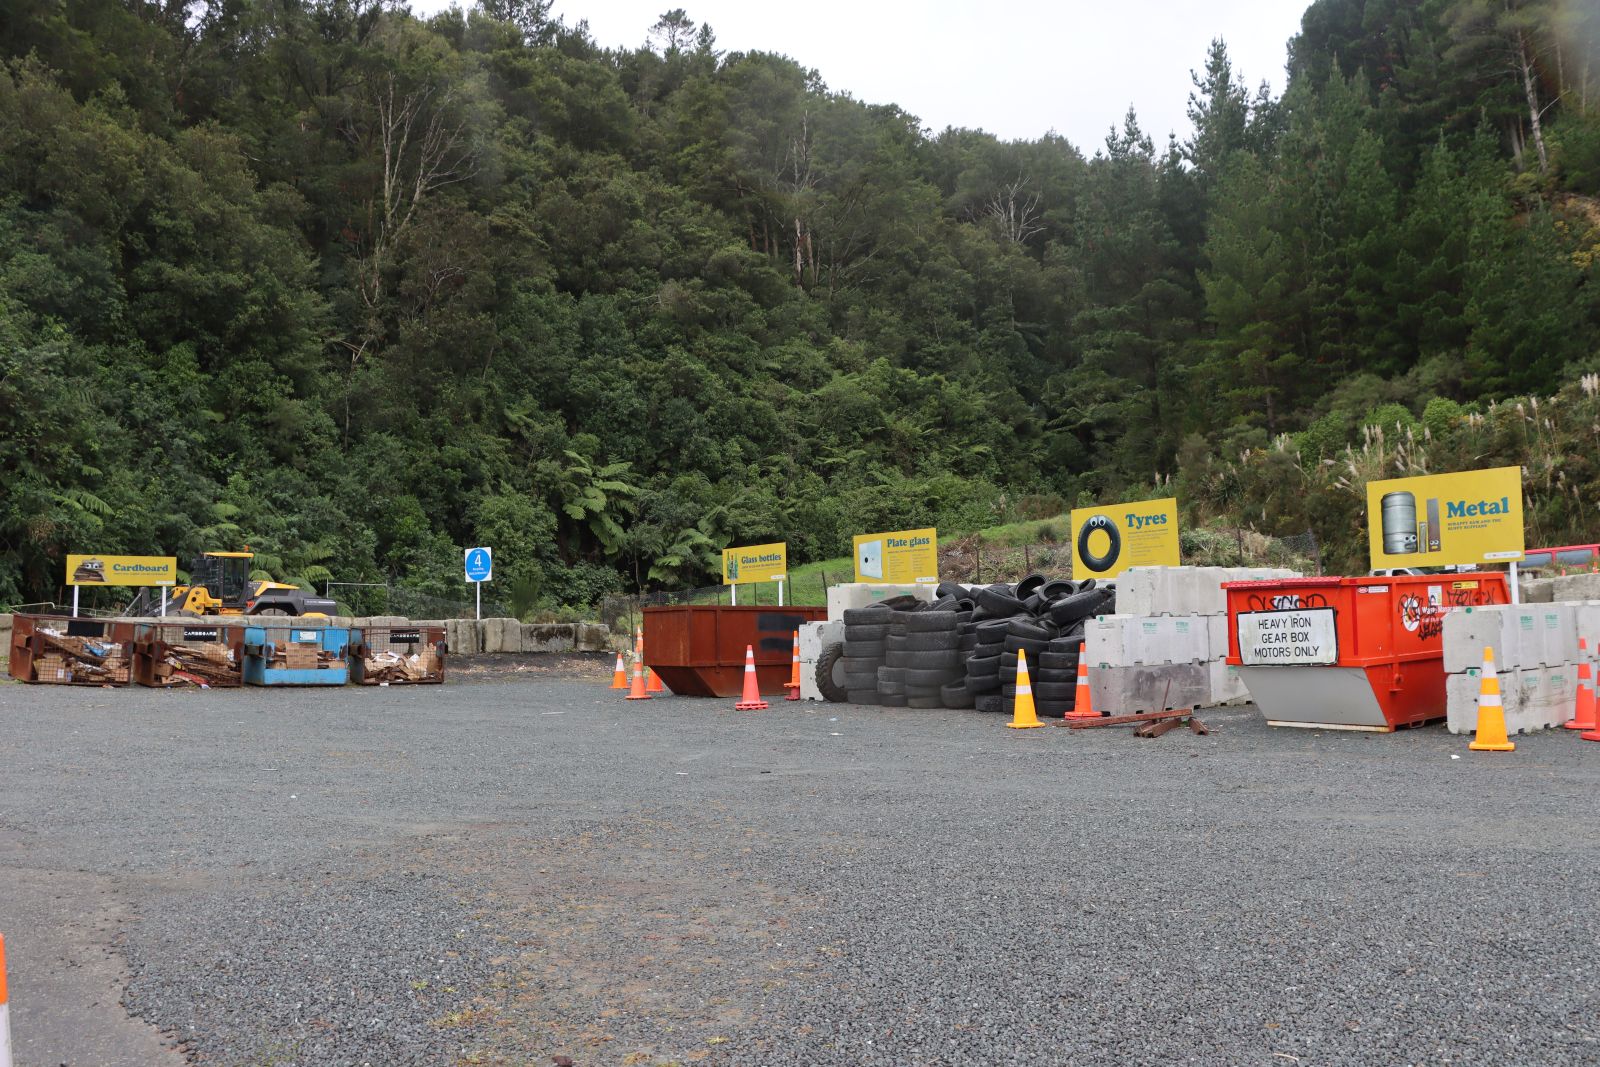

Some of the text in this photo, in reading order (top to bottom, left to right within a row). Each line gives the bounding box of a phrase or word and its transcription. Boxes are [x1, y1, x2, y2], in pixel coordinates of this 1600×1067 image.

[1446, 496, 1509, 518] Metal
[1125, 513, 1168, 530] Tyres
[887, 536, 930, 548] Plate glass
[474, 554, 482, 567] 4
[742, 554, 782, 564] Glass bottles
[112, 563, 168, 572] Cardboard
[1258, 617, 1312, 630] HEAVY IRON
[1262, 632, 1310, 644] GEAR BOX
[1254, 646, 1320, 658] MOTORS ONLY
